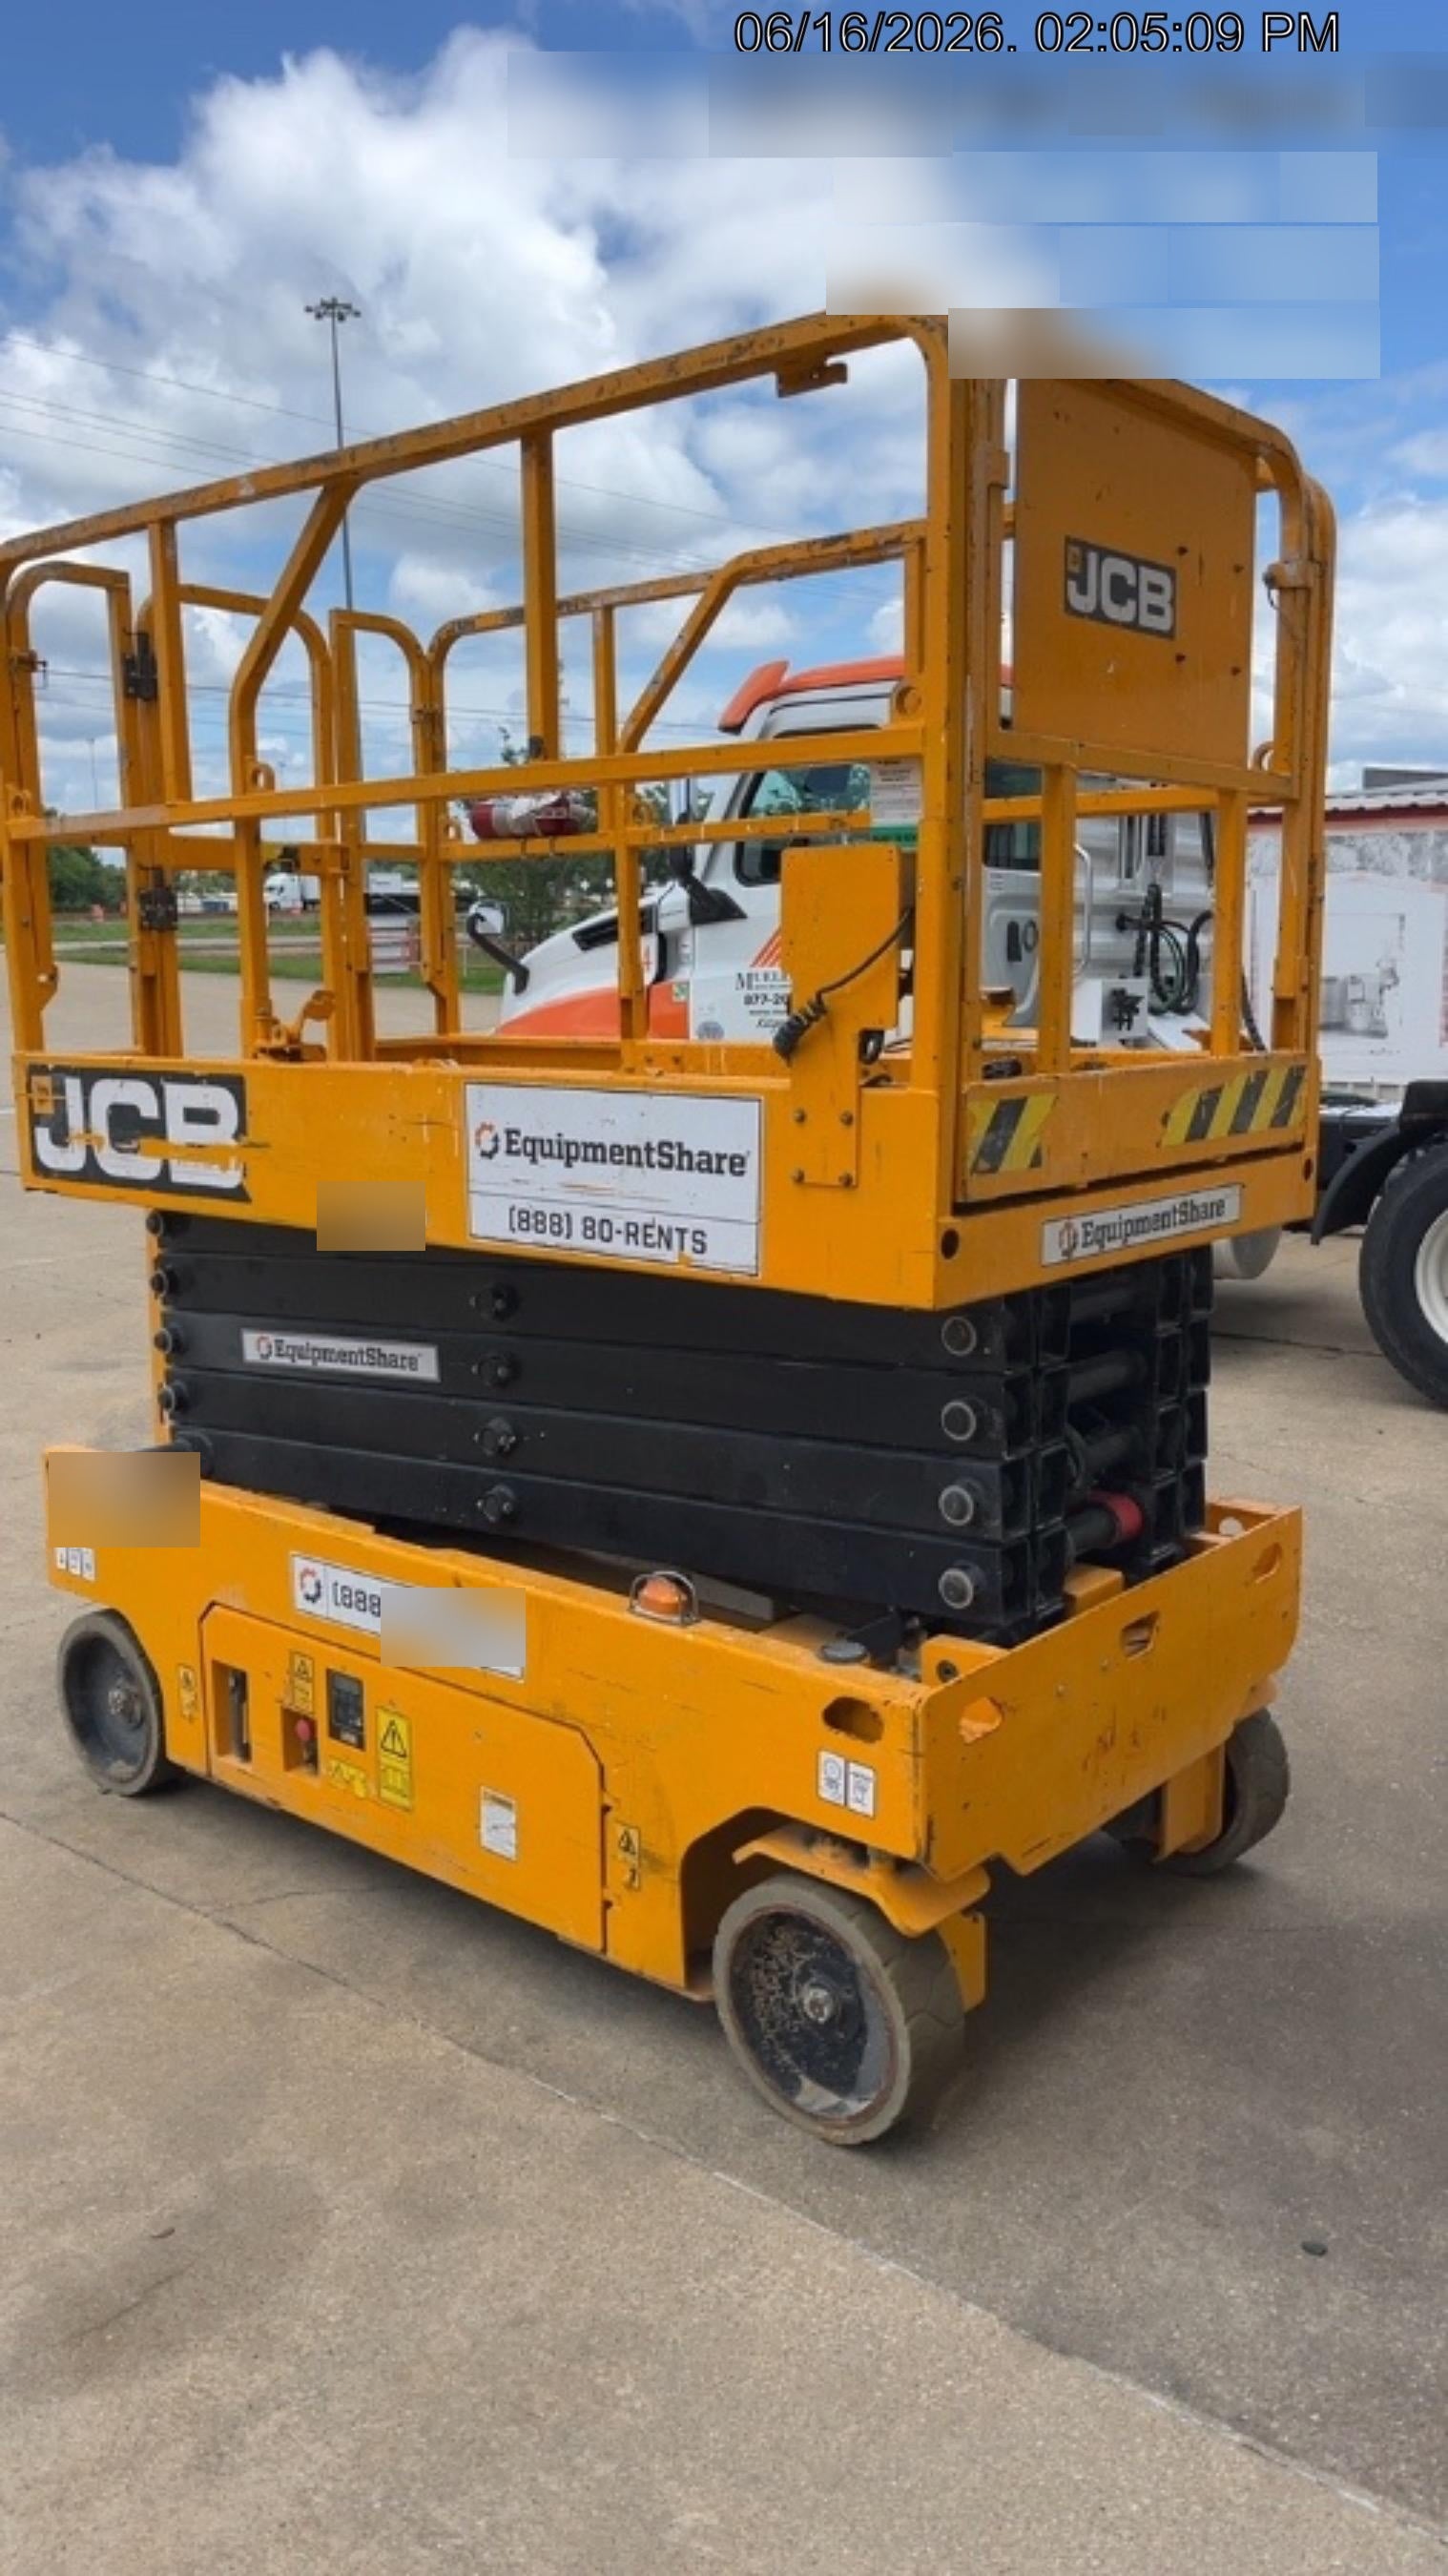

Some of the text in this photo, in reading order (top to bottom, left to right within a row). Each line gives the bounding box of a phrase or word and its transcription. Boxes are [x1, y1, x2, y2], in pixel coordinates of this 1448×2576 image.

[1066, 550, 1172, 633] JCB
[34, 1076, 243, 1189] JCB
[504, 1128, 747, 1177] EquipmentShare
[508, 1204, 708, 1255] (888) 80-RENTS
[1081, 1198, 1226, 1254] EquipmentShare
[274, 1339, 419, 1372] EquipmentShare
[333, 1581, 382, 1618] (888
